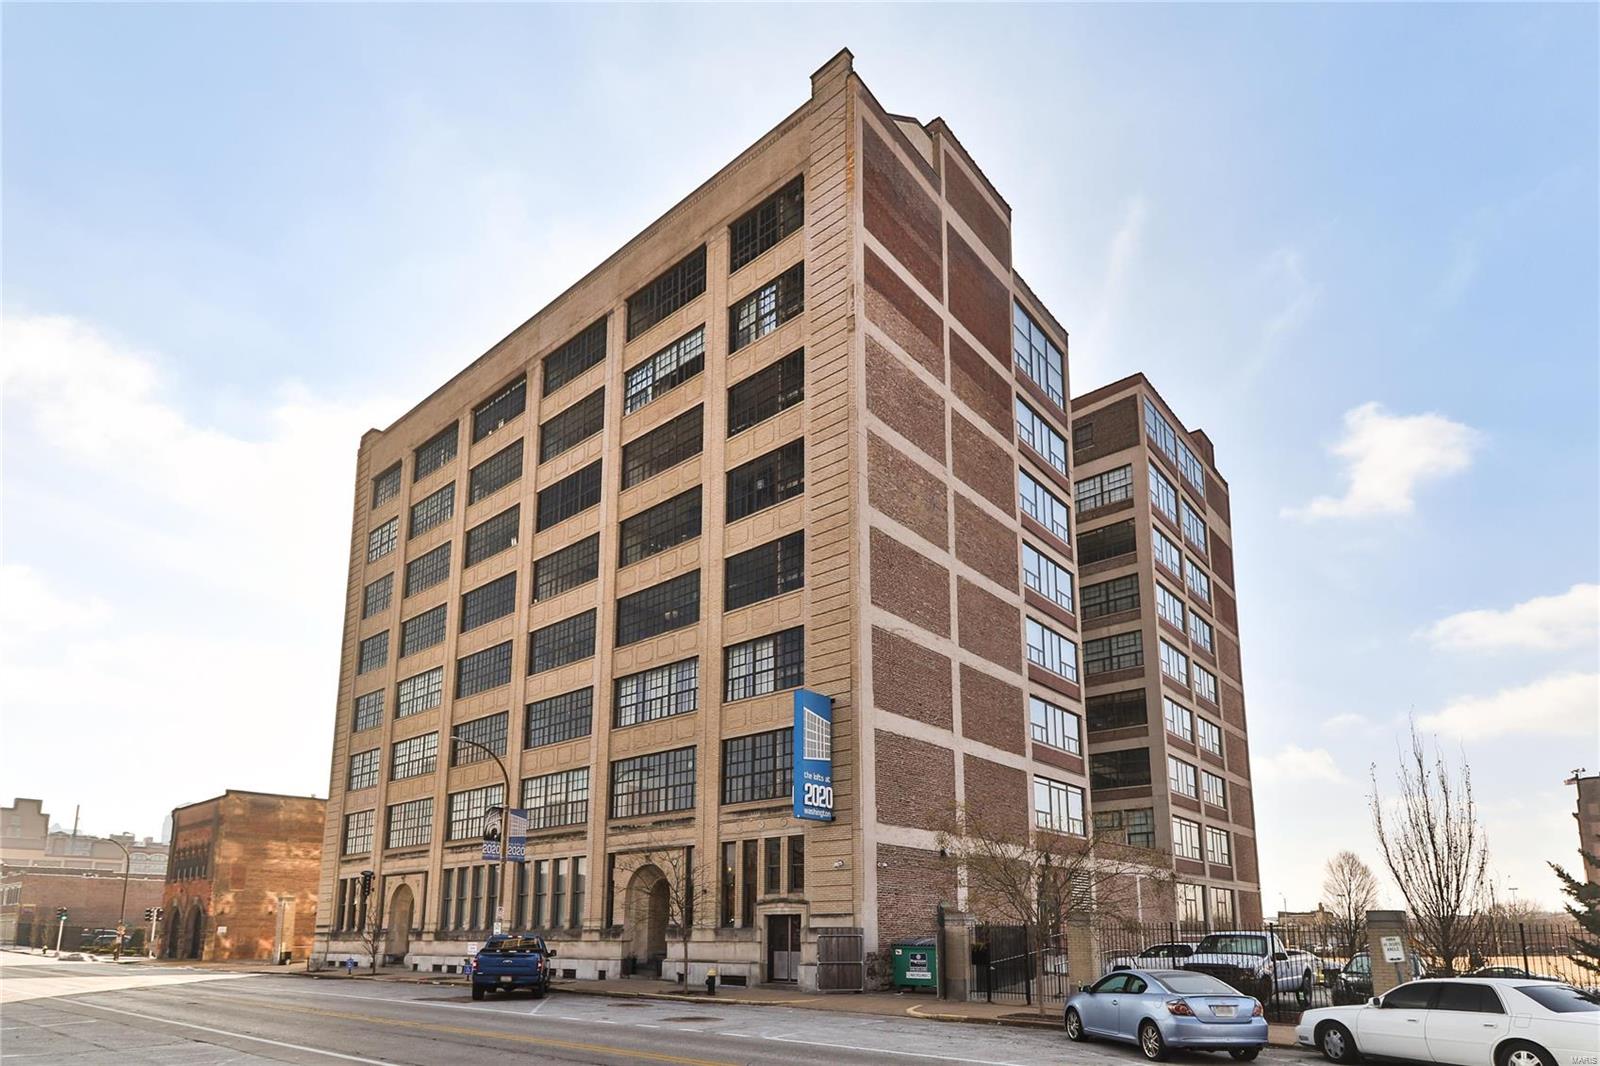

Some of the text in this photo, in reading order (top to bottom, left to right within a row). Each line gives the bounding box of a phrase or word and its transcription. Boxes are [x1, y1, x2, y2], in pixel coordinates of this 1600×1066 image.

[804, 771, 812, 779] the
[804, 783, 833, 809] 2020
[804, 808, 831, 818] washington
[482, 843, 500, 855] 2020
[508, 845, 525, 856] 2020
